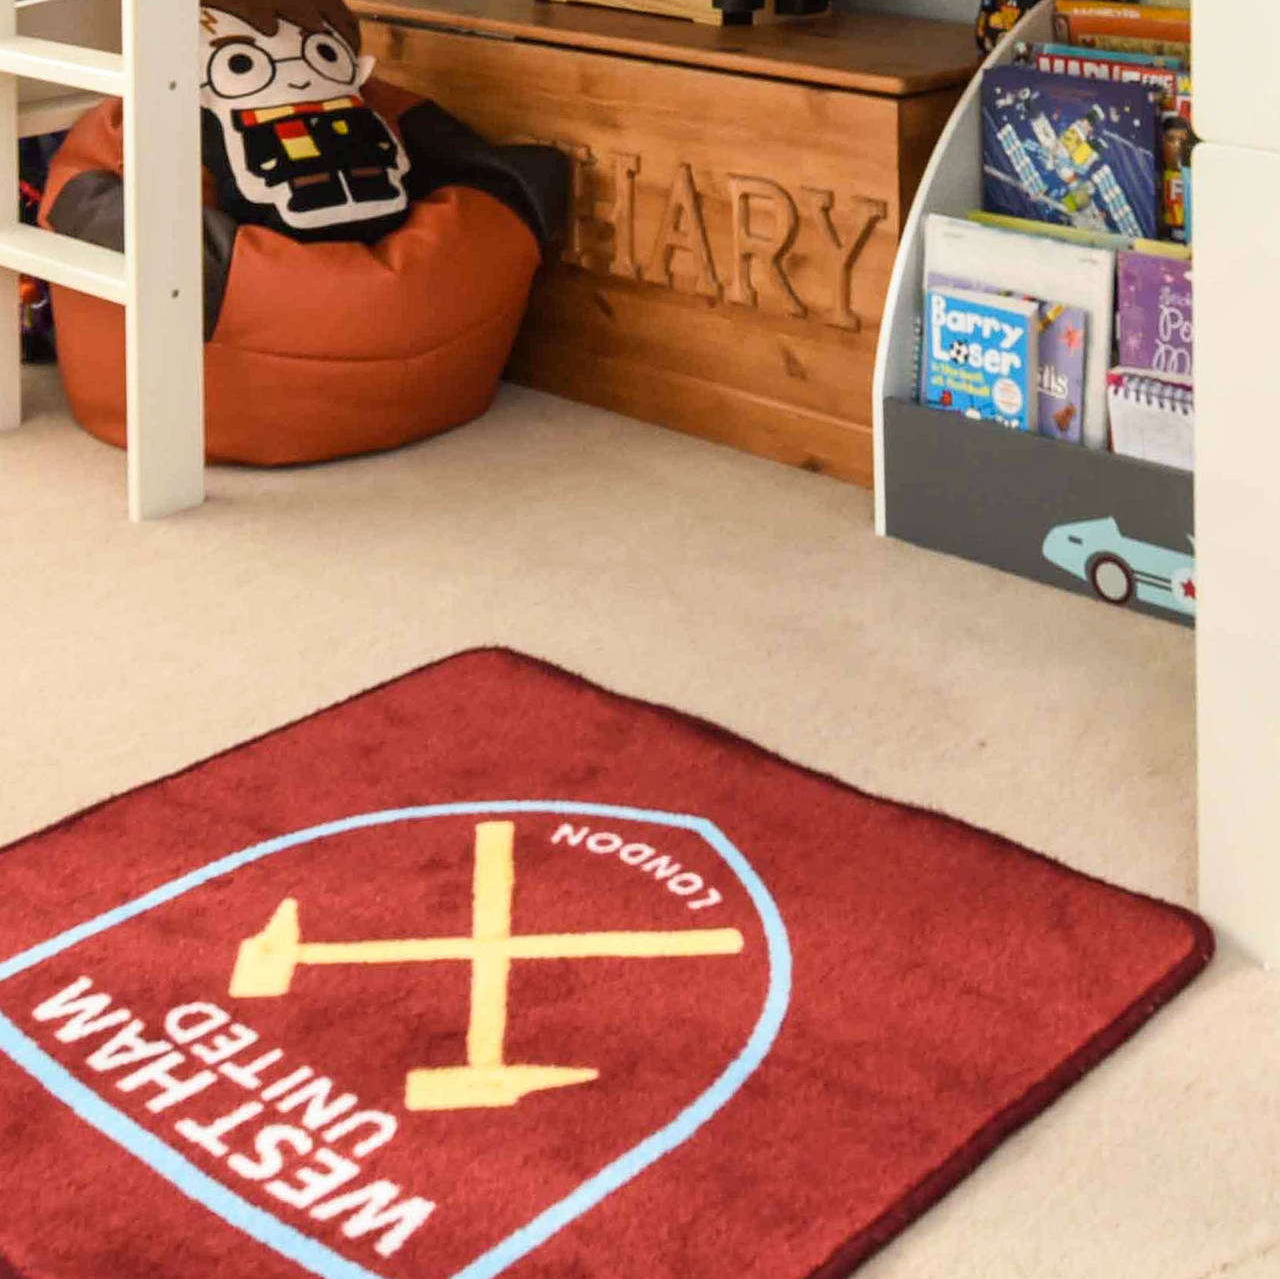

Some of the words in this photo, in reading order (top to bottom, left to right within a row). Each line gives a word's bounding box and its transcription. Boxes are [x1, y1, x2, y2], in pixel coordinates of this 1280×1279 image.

[931, 294, 1023, 348] Barry
[931, 324, 1022, 375] Loser
[551, 823, 720, 911] LONDON
[31, 975, 215, 1109] HAM
[165, 1000, 398, 1147] UNITED
[175, 1101, 438, 1259] WEST
